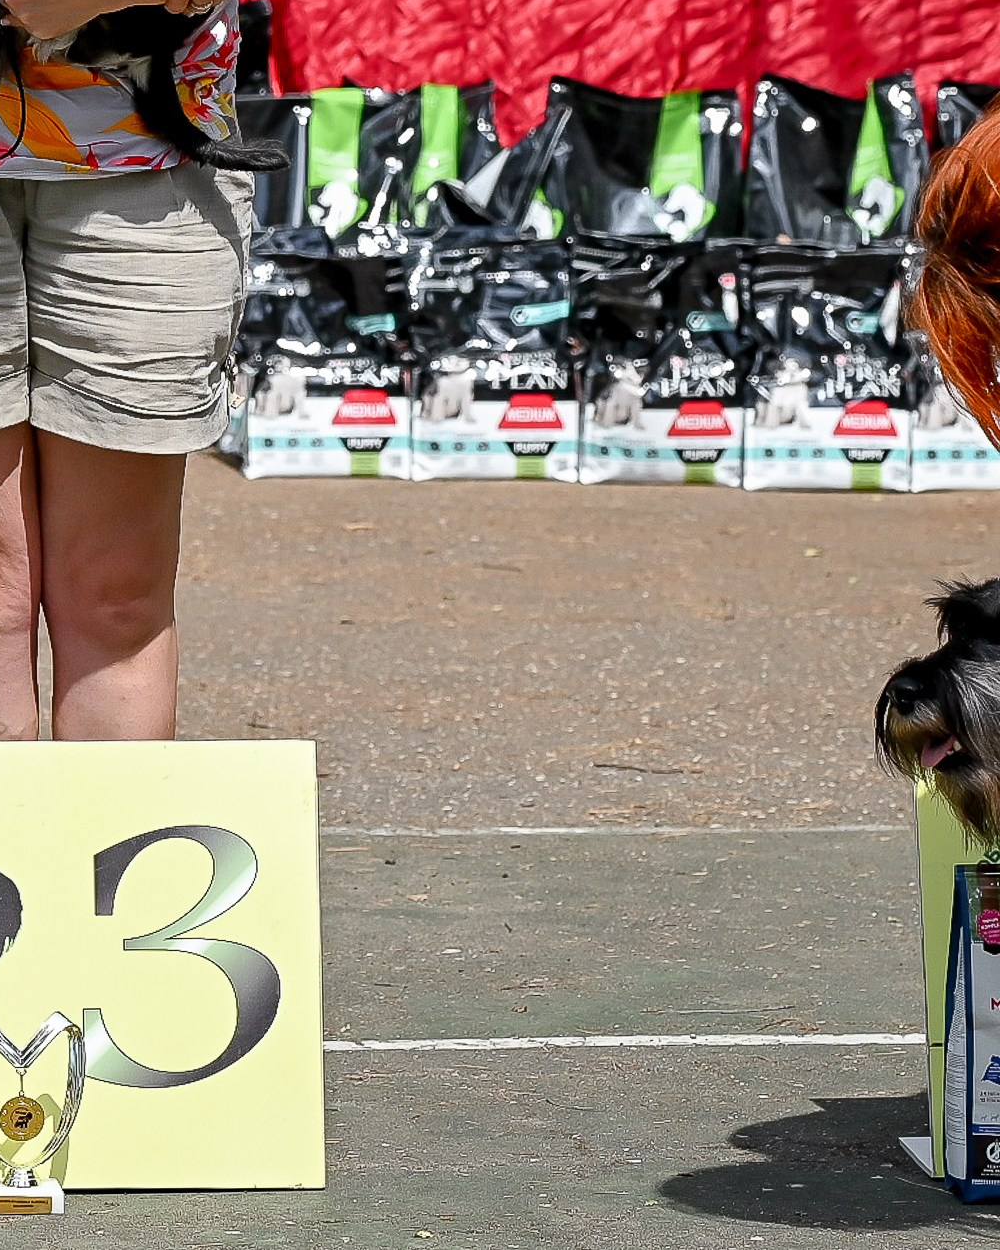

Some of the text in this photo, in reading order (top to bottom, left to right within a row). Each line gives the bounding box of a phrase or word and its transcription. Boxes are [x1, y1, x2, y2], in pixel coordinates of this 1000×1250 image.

[661, 377, 737, 397] PLAN
[340, 403, 389, 417] MEDIUM
[507, 407, 556, 421] MEDIUM
[675, 415, 724, 430] MEDIUM
[842, 415, 889, 429] MEDIUM
[83, 825, 280, 1088] 3
